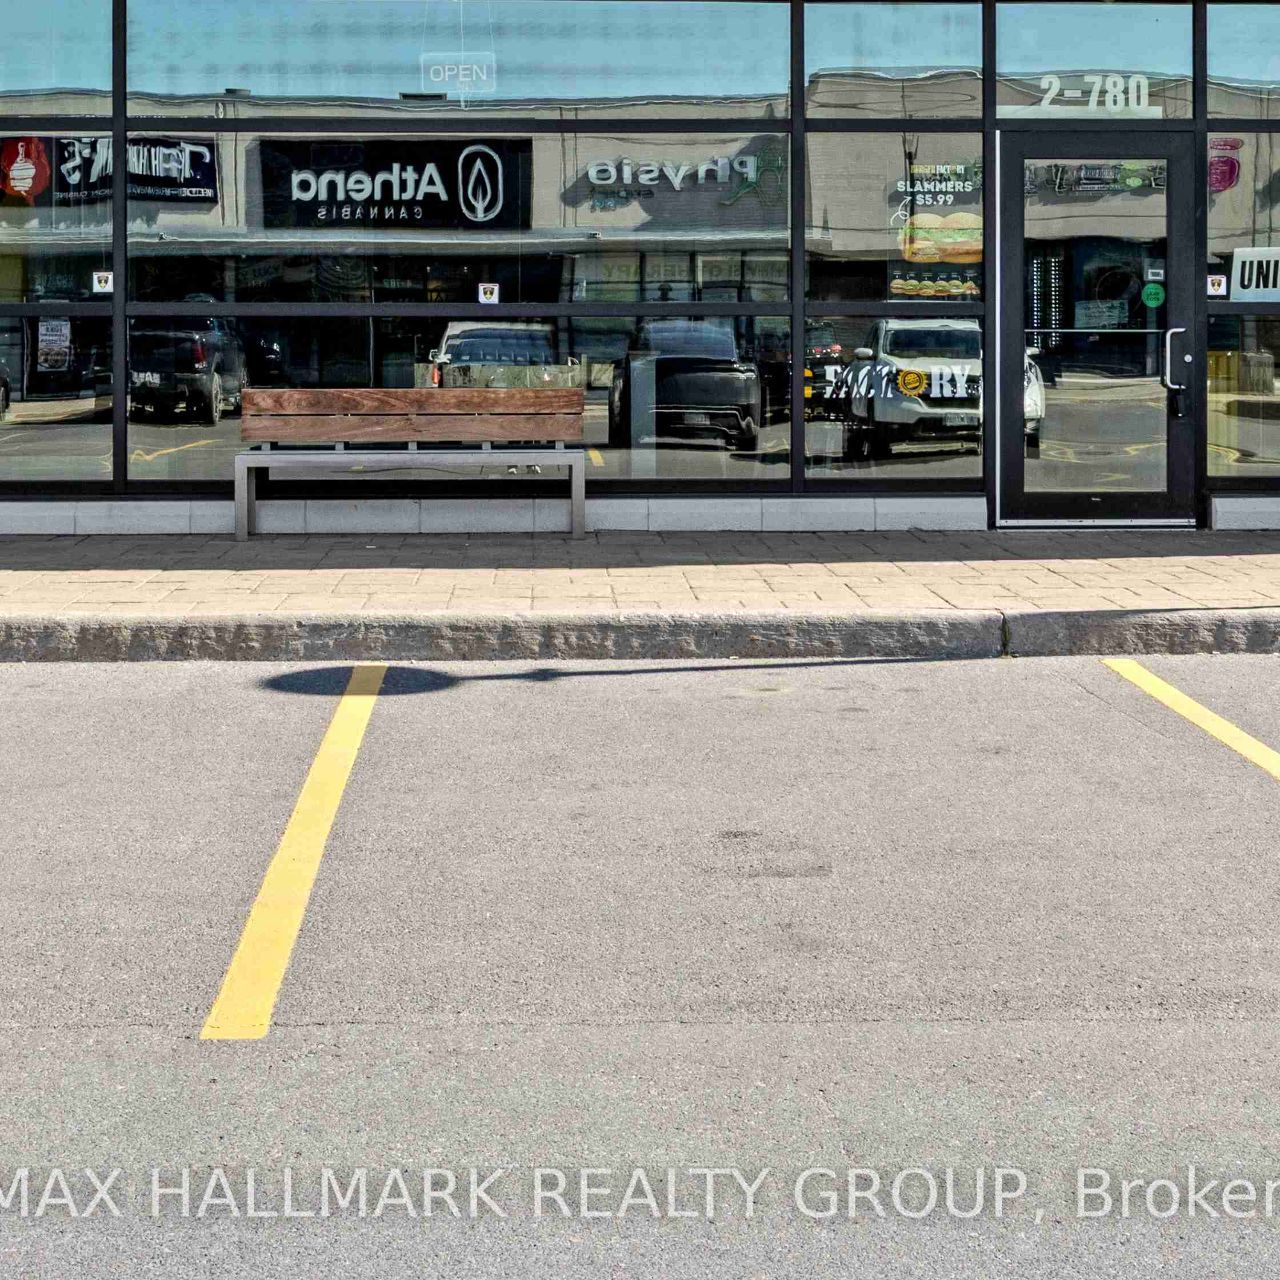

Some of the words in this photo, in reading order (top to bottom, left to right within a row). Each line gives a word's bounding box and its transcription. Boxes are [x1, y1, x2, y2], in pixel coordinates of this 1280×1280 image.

[430, 64, 487, 81] OPEN
[1040, 74, 1149, 112] 2-780
[897, 180, 973, 192] SLAMMERS
[915, 194, 954, 205] $5.99
